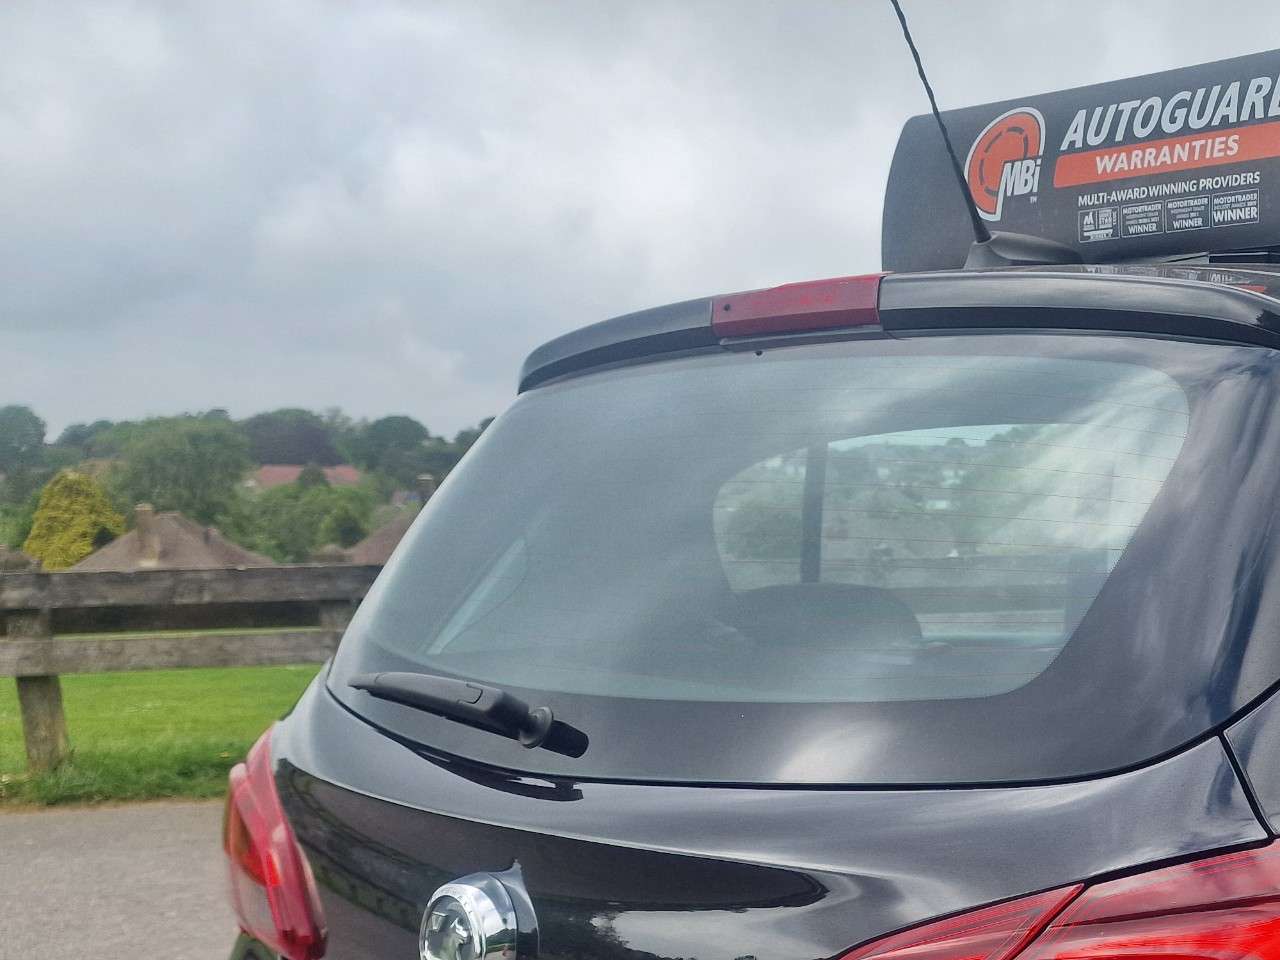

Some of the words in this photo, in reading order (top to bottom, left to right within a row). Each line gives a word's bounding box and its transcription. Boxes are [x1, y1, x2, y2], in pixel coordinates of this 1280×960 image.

[1095, 135, 1240, 174] WARRANTIES
[1078, 186, 1148, 208] MULTI-AWARD
[1148, 180, 1197, 198] WINNING
[1199, 171, 1260, 191] PROVIDERS
[1213, 192, 1258, 206] MOTORTRADER
[1213, 206, 1258, 223] WINNER
[1128, 222, 1158, 235] WINNER
[1172, 217, 1203, 230] WINNER
